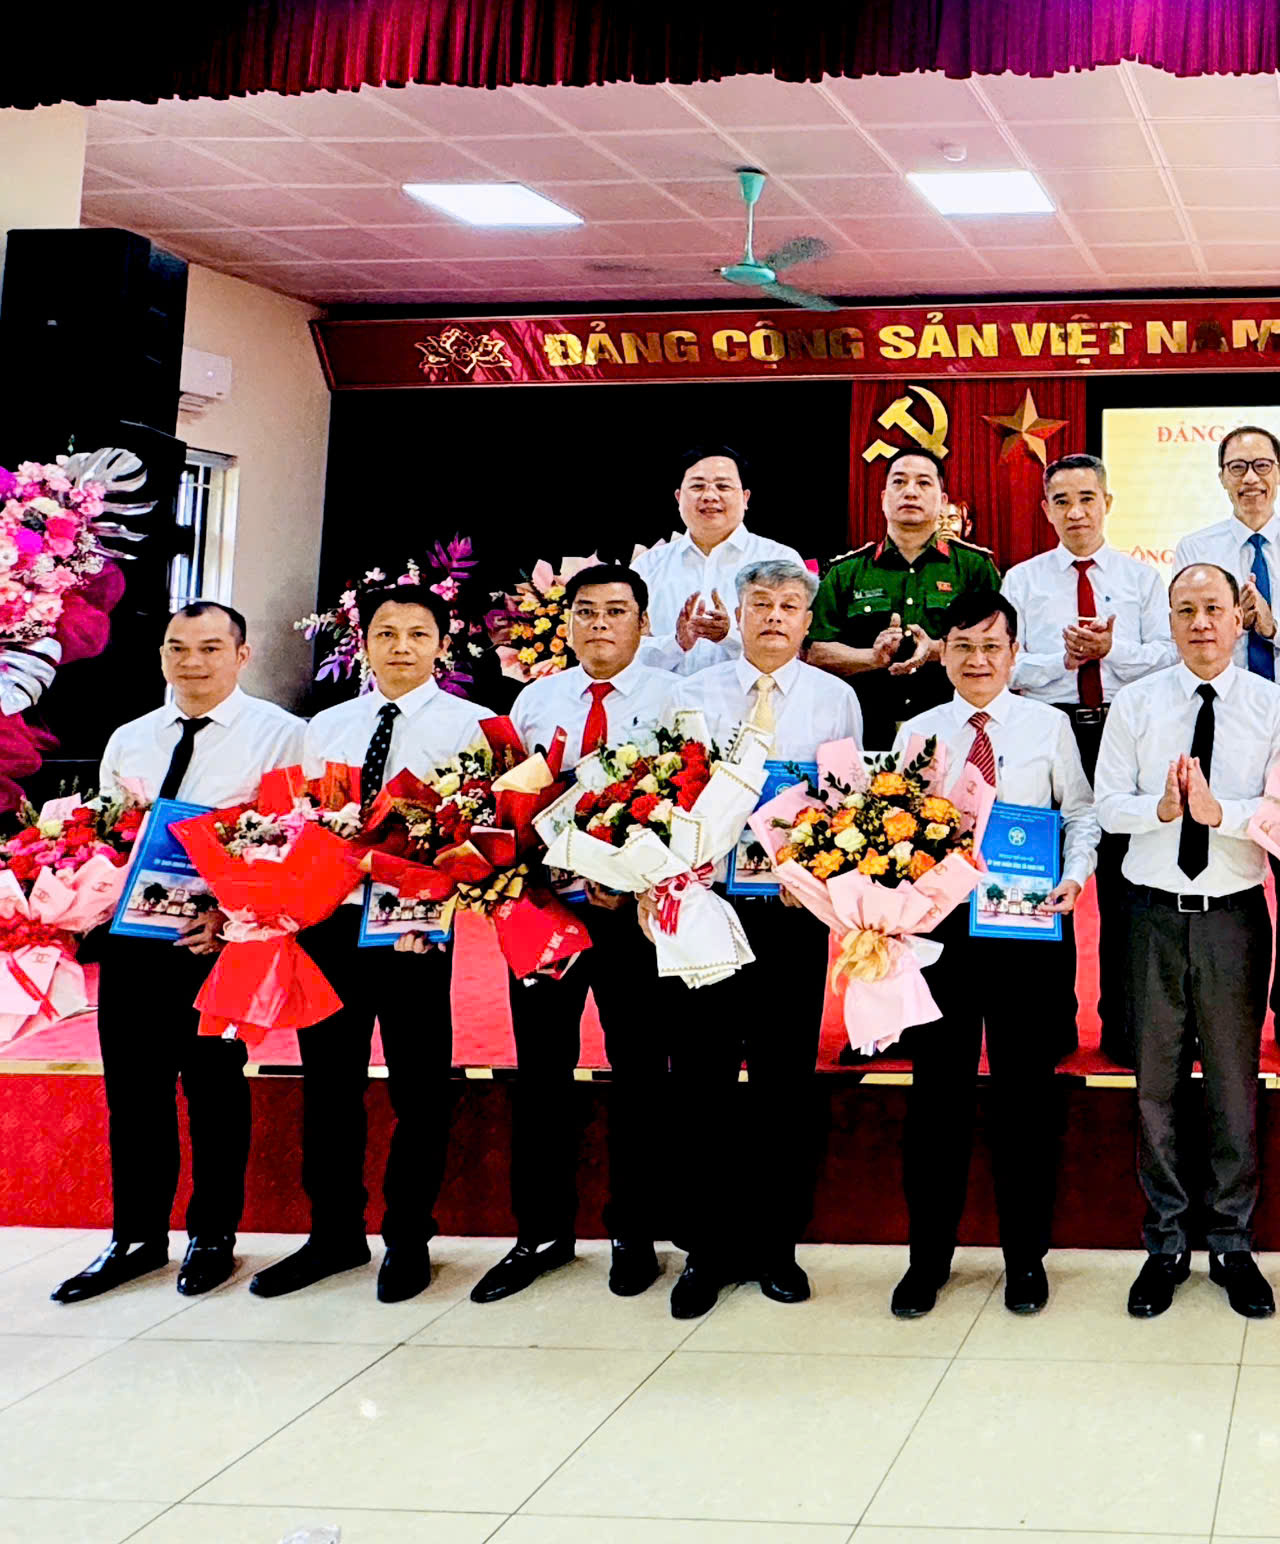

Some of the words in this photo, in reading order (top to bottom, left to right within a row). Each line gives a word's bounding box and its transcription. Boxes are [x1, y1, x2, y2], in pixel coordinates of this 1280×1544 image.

[544, 320, 699, 367] ĐẢNG
[712, 320, 865, 369] CỘNG
[878, 312, 999, 360] SẢN
[1011, 313, 1132, 364] VIỆT
